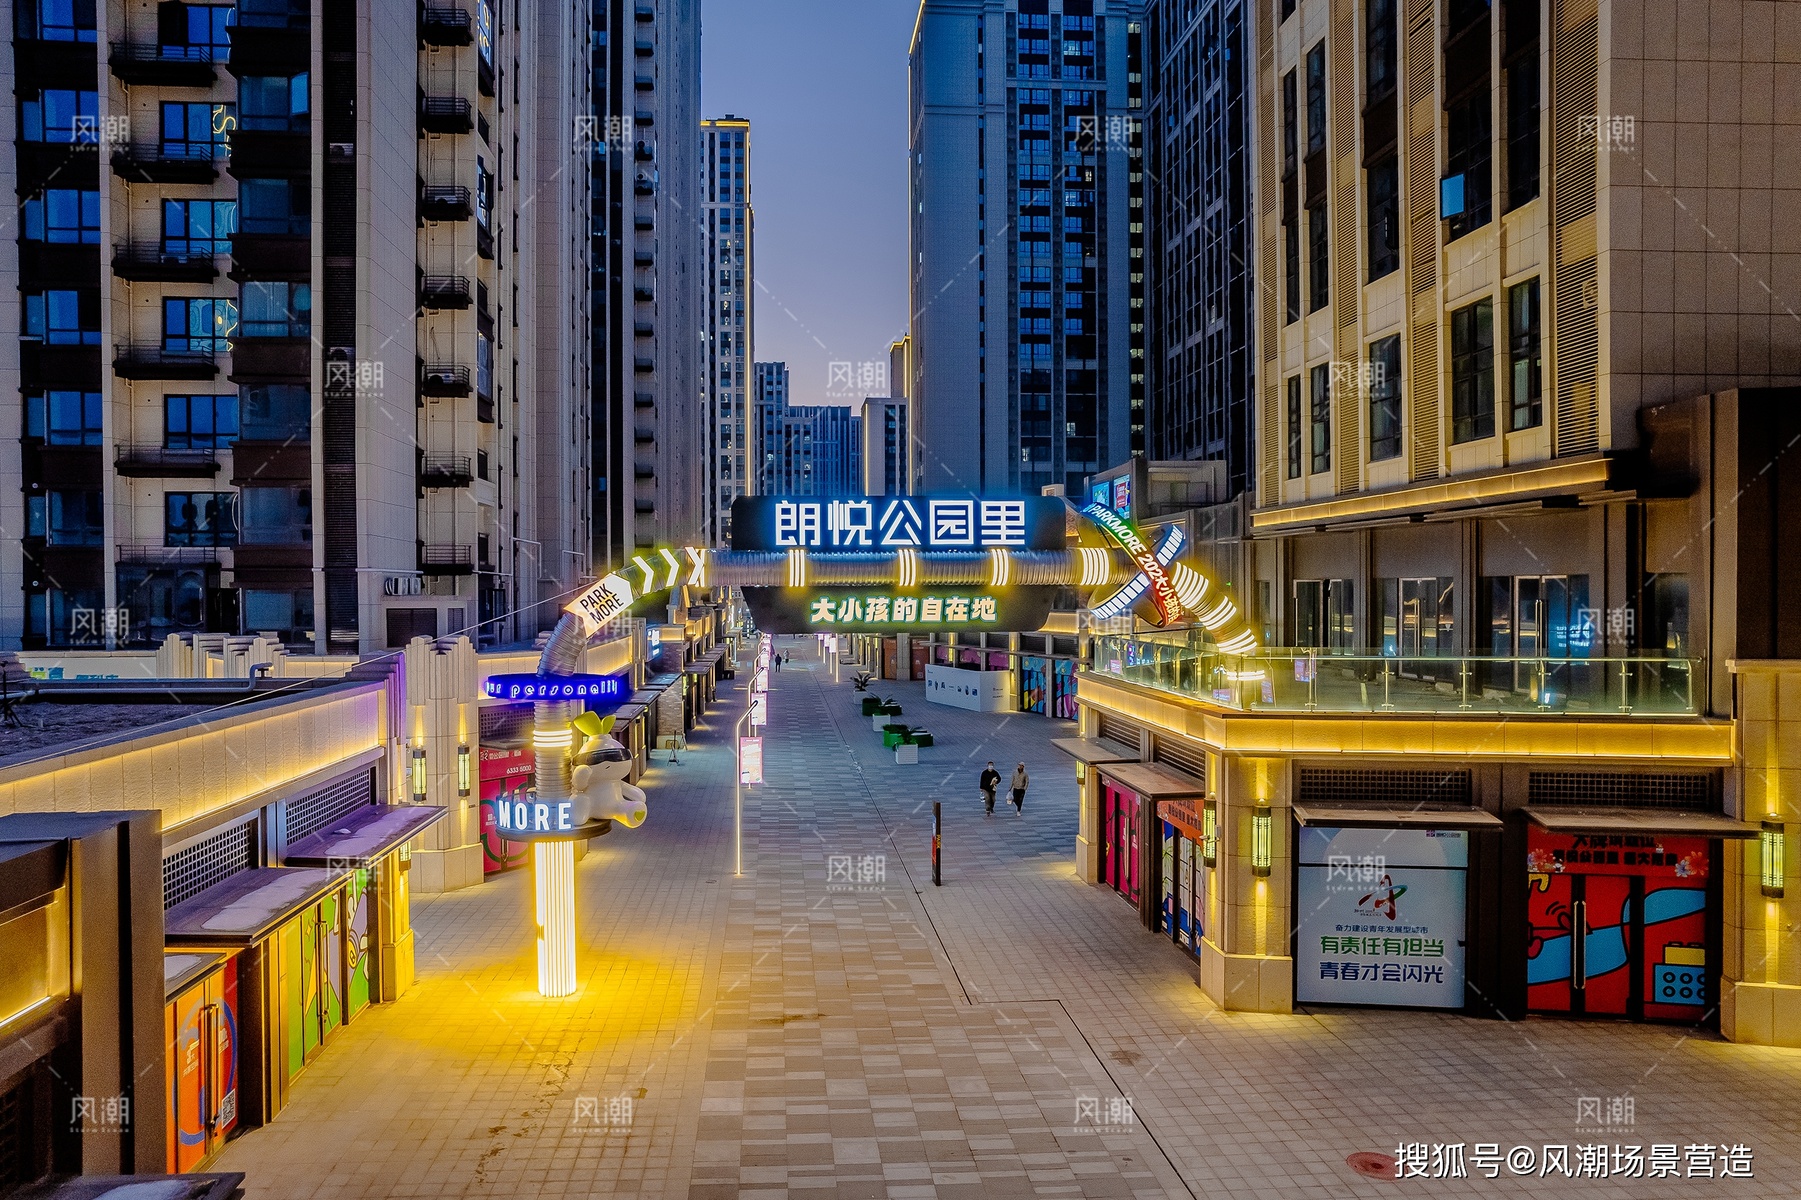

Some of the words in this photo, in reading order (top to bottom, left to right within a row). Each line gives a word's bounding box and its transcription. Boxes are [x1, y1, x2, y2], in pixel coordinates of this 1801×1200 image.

[774, 500, 1026, 546] 朗悦公园里
[1088, 504, 1147, 555] PARKMORE
[580, 583, 613, 612] PARK
[590, 594, 624, 624] MORE
[810, 596, 999, 623] 大小孩的自在地
[498, 800, 572, 831] MORE
[1335, 924, 1429, 934] 奋力建设青年发展型城市
[1320, 936, 1445, 957] 有责任有担当
[1319, 961, 1444, 984] 青春才会闪光
